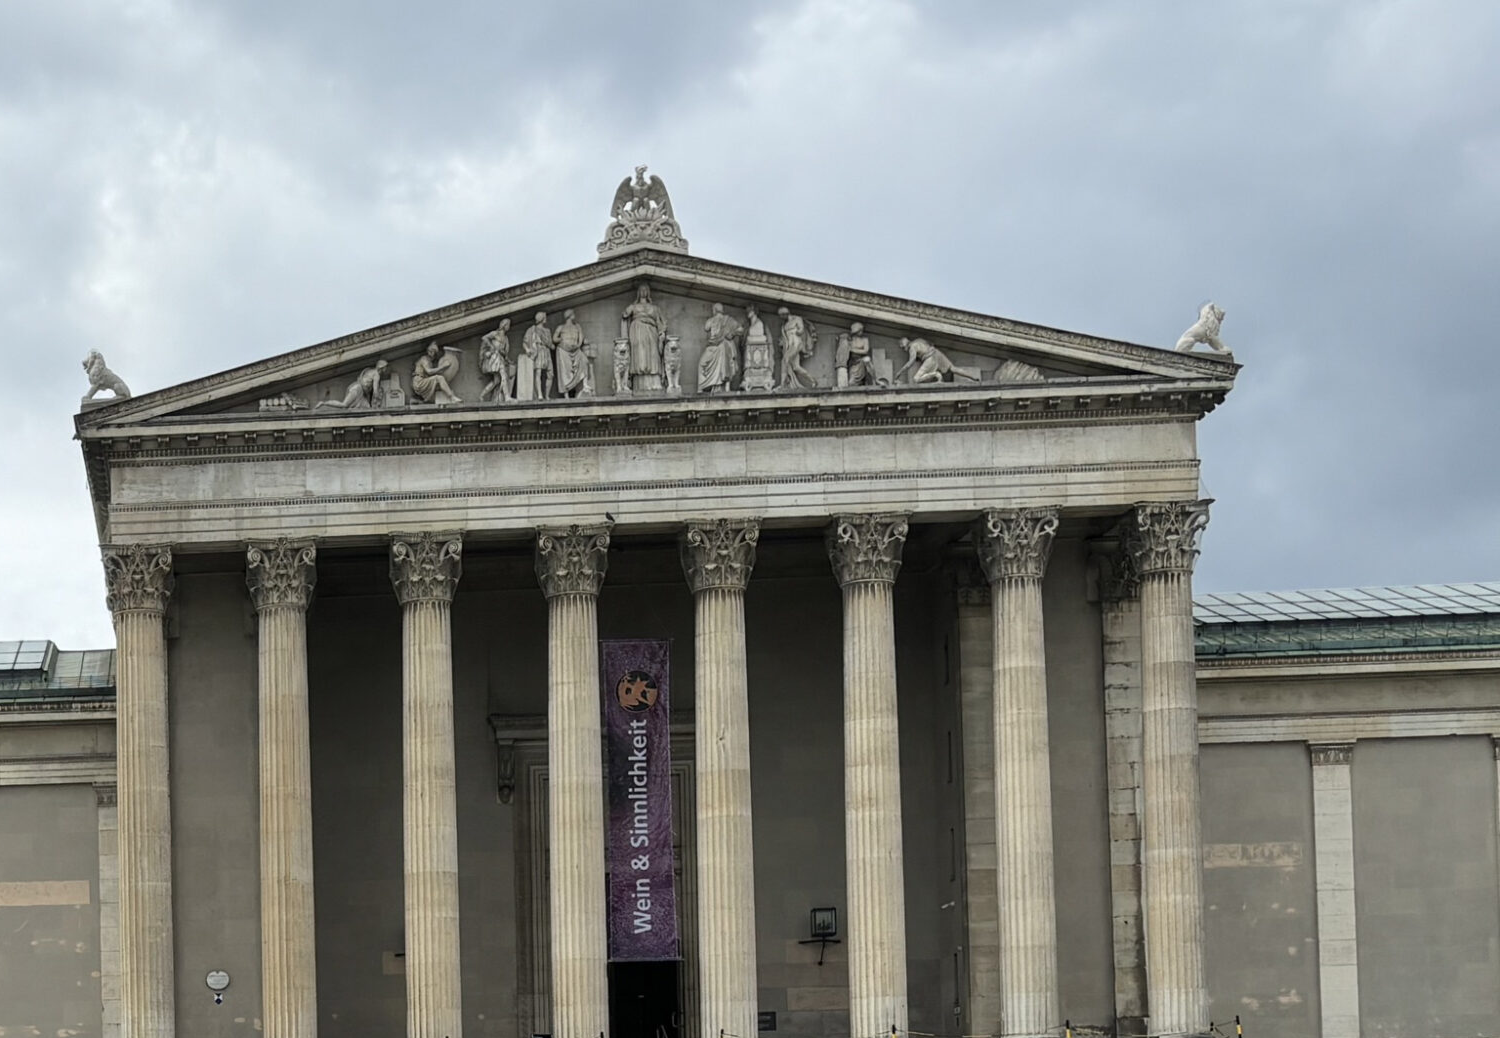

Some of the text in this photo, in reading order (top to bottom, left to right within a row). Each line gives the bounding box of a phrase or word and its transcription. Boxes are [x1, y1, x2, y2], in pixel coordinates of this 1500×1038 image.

[628, 719, 652, 934] Wein & Sinnlichkeit
